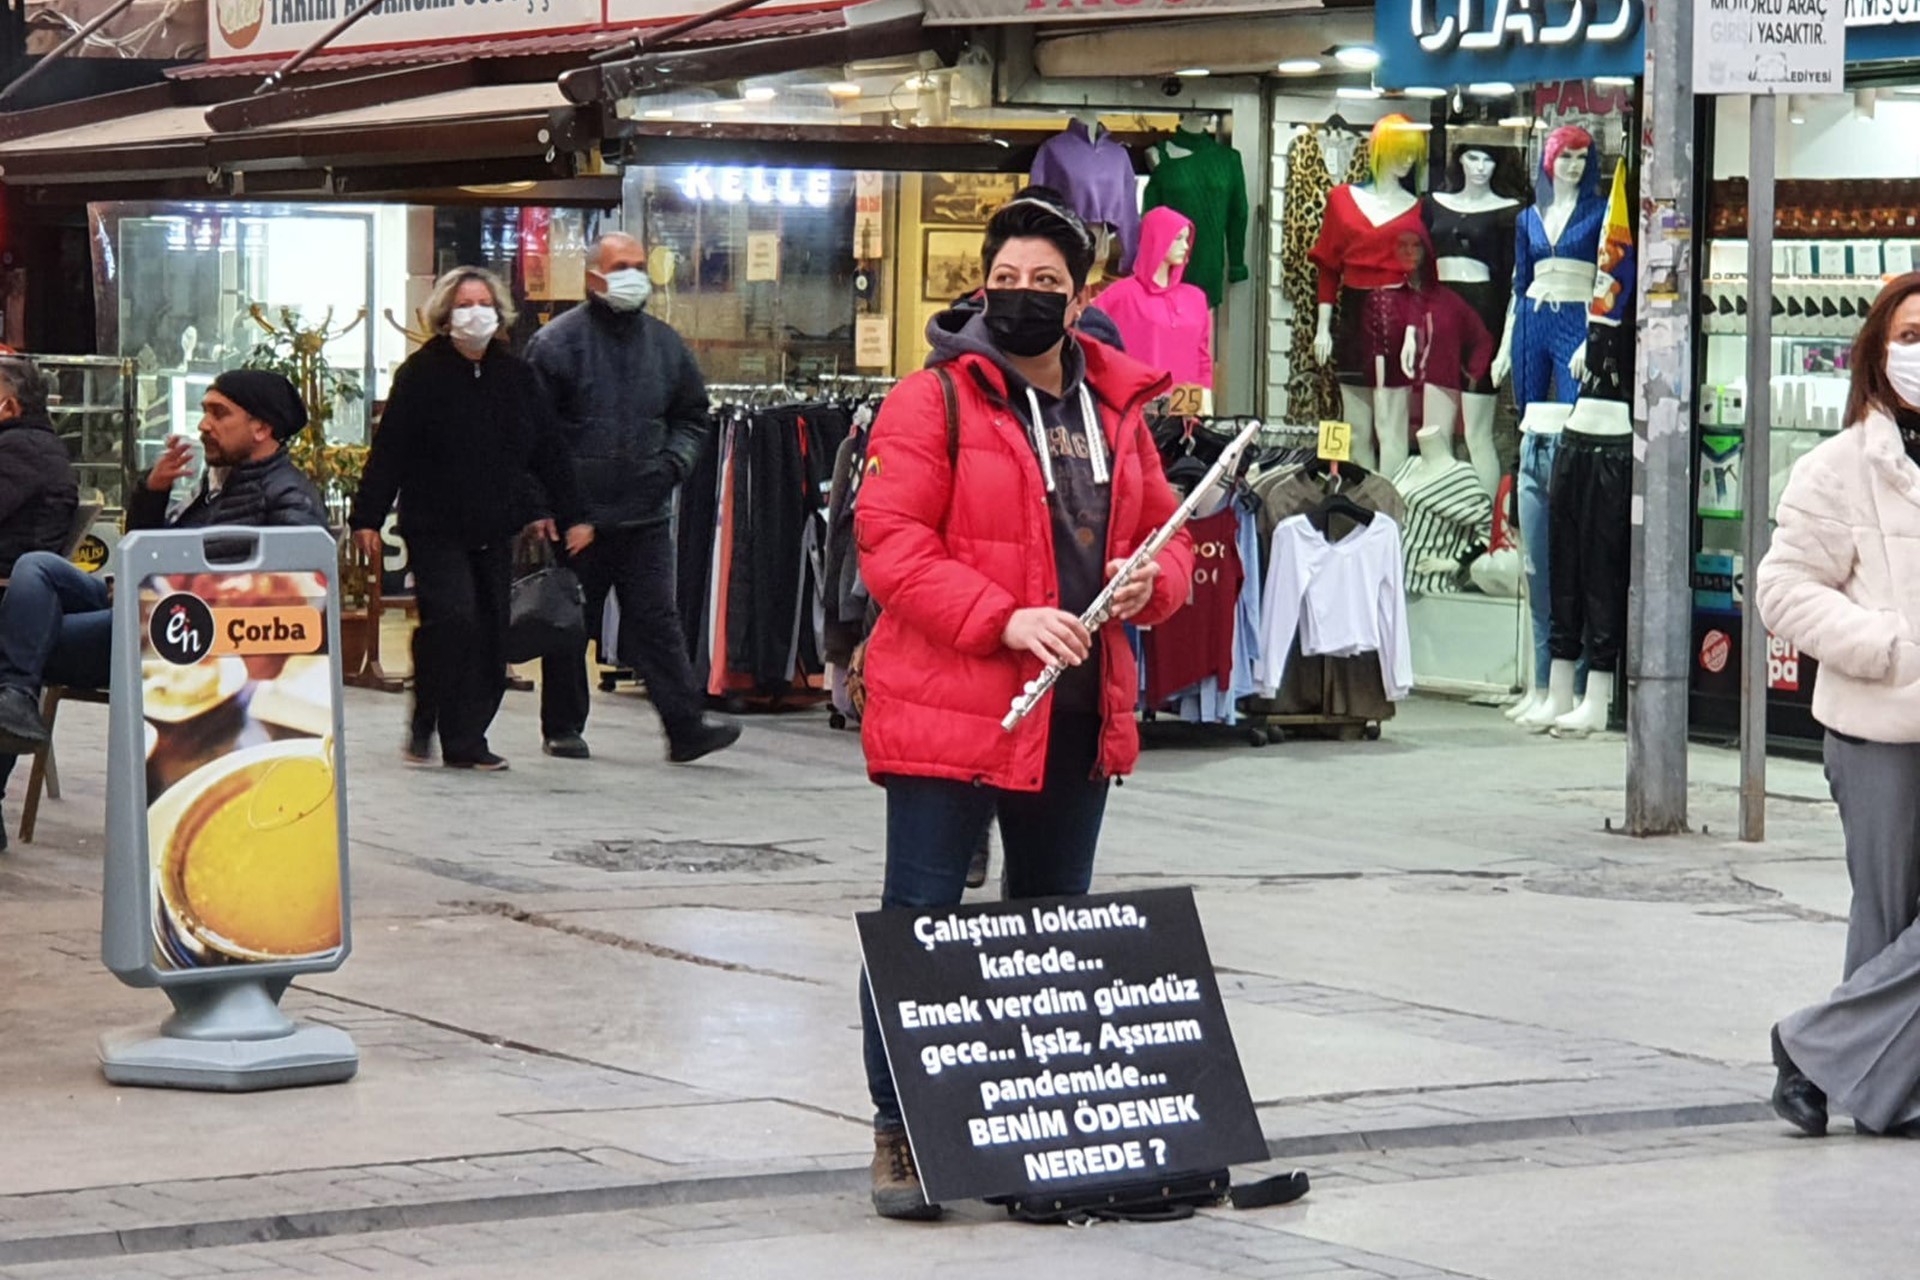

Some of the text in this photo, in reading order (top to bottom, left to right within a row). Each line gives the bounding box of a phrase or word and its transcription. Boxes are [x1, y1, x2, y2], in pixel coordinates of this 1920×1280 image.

[1757, 21, 1828, 45] YASAKTIR.
[683, 166, 831, 207] KELLE
[1170, 387, 1201, 415] 25
[1324, 425, 1345, 452] 15
[227, 616, 306, 649] Çorba
[1767, 658, 1799, 688] pa
[914, 902, 1147, 950] Çalıştım lokanta,
[979, 947, 1103, 980] kafede...
[899, 974, 1200, 1028] Emek verdim gündüz
[920, 1040, 1016, 1075] gece...
[1099, 1018, 1202, 1055] Aşsızım
[980, 1062, 1167, 1110] pandemide...
[968, 1094, 1200, 1147] BENİM ÖDENEK
[1024, 1138, 1166, 1182] NEREDE ?
